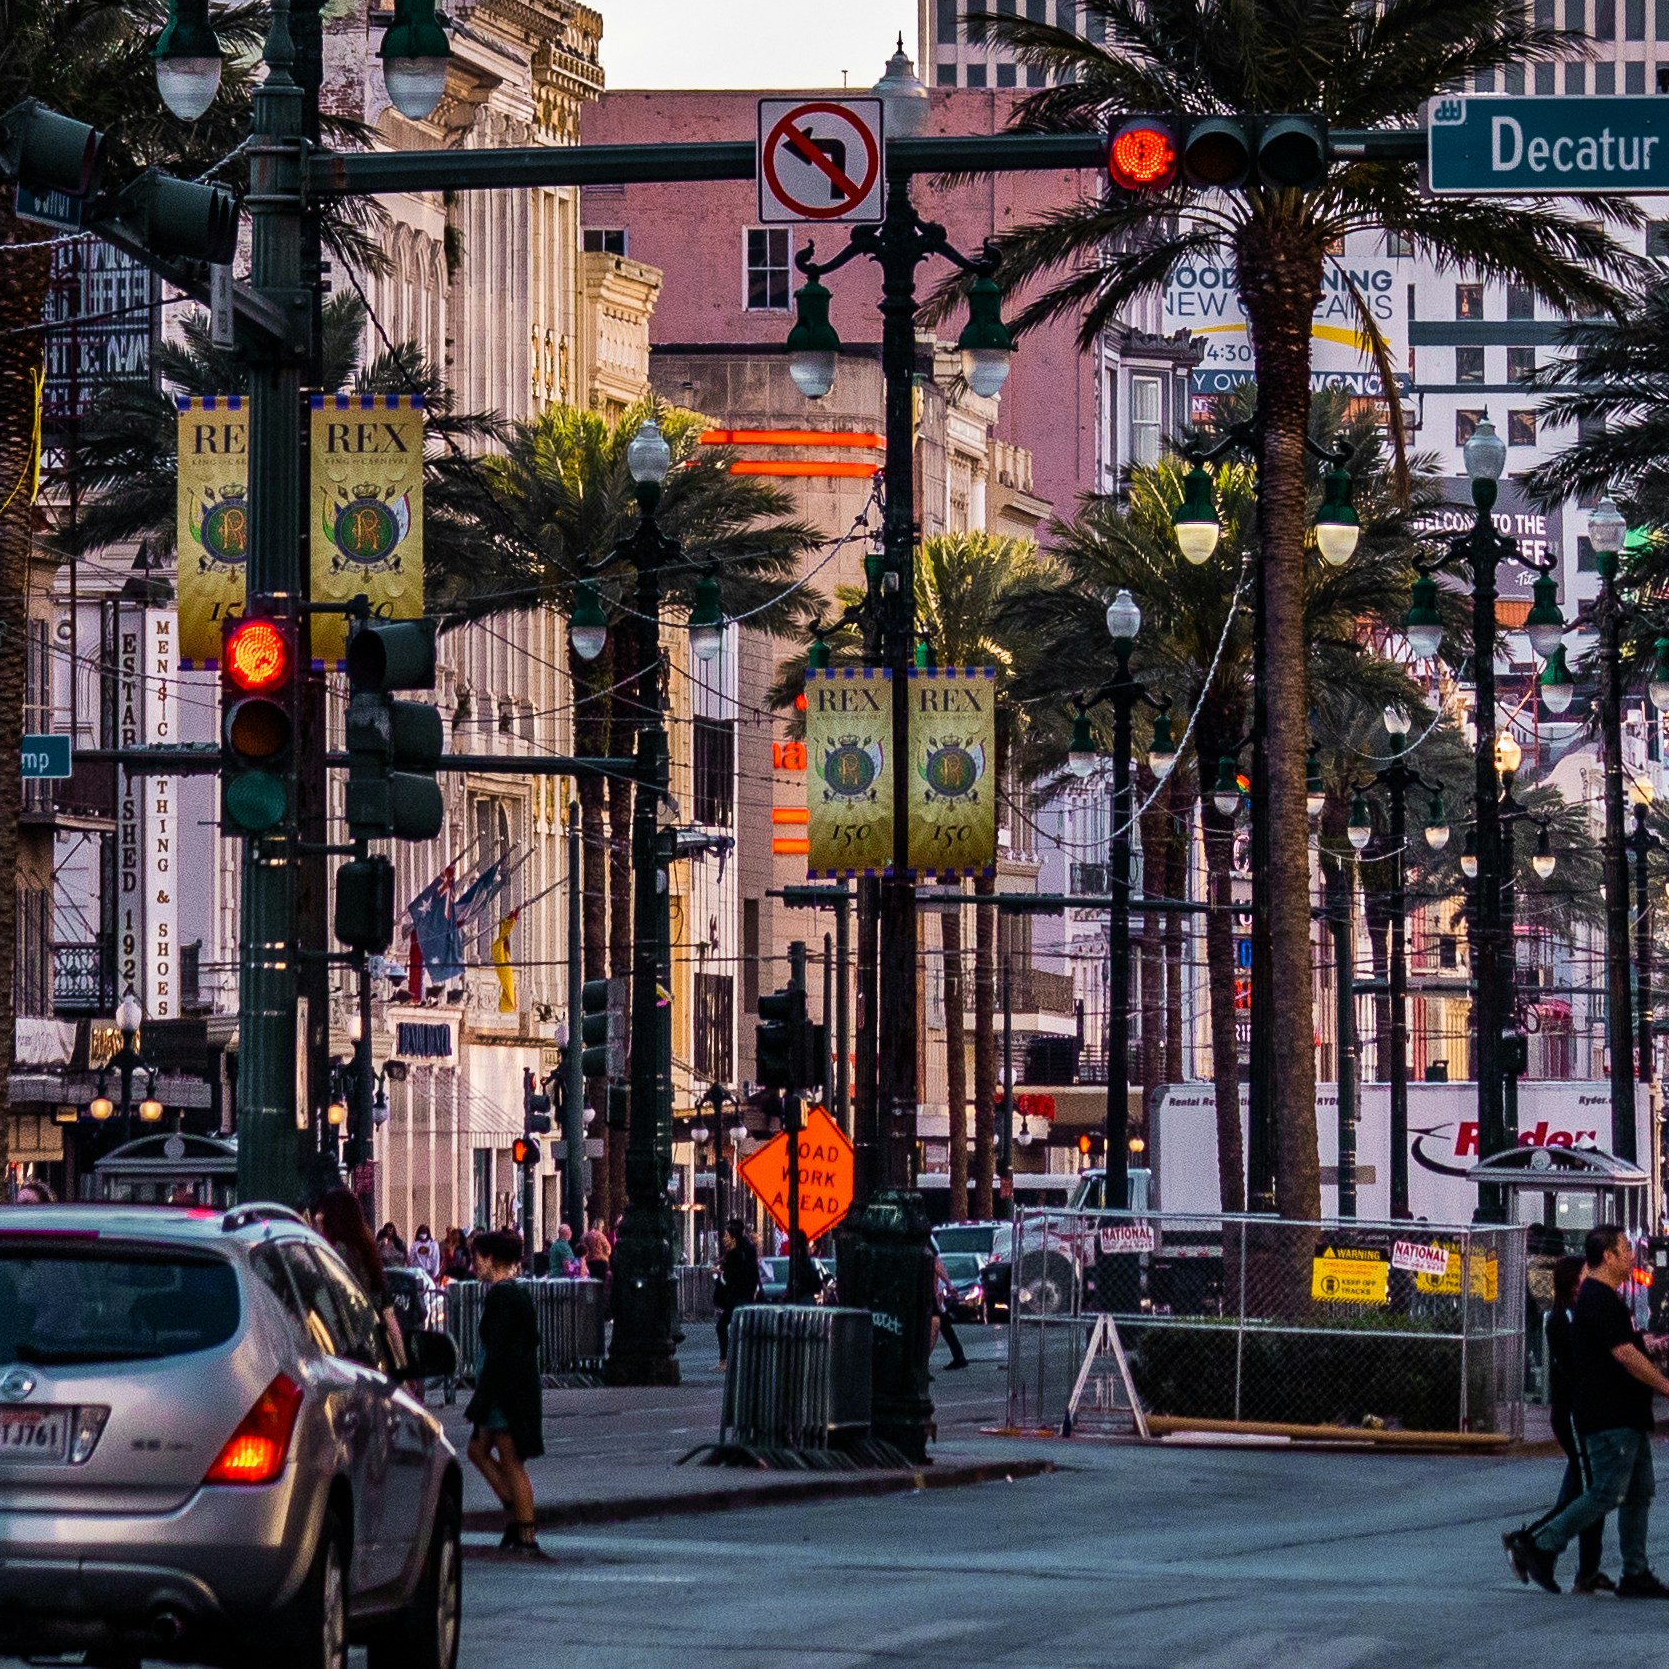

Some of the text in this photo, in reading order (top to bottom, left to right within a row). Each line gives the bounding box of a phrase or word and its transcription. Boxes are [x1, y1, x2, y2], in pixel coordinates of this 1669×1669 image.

[1491, 115, 1660, 173] Decatur
[1322, 269, 1393, 292] NING
[1165, 291, 1228, 317] NEW
[1206, 344, 1252, 362] 4:30
[1213, 373, 1257, 391] OW
[192, 423, 246, 454] RE
[326, 422, 410, 454] REX
[1515, 514, 1547, 535] THE
[817, 688, 881, 713] REX
[919, 688, 983, 713] REX
[21, 752, 50, 774] mp
[121, 634, 138, 893] ESTABISHED
[156, 722, 170, 873] CTHING
[832, 824, 872, 847] 150
[933, 824, 973, 847] 150
[157, 923, 169, 1016] SHOES
[1579, 1095, 1612, 1106] Ryder.
[1454, 1121, 1597, 1157] Rder
[785, 1142, 839, 1163] OAD
[772, 1191, 839, 1214] AEAD
[1102, 1227, 1152, 1241] NATIONAL
[1337, 1248, 1381, 1261] WARNING
[1395, 1242, 1446, 1263] NATIONAL
